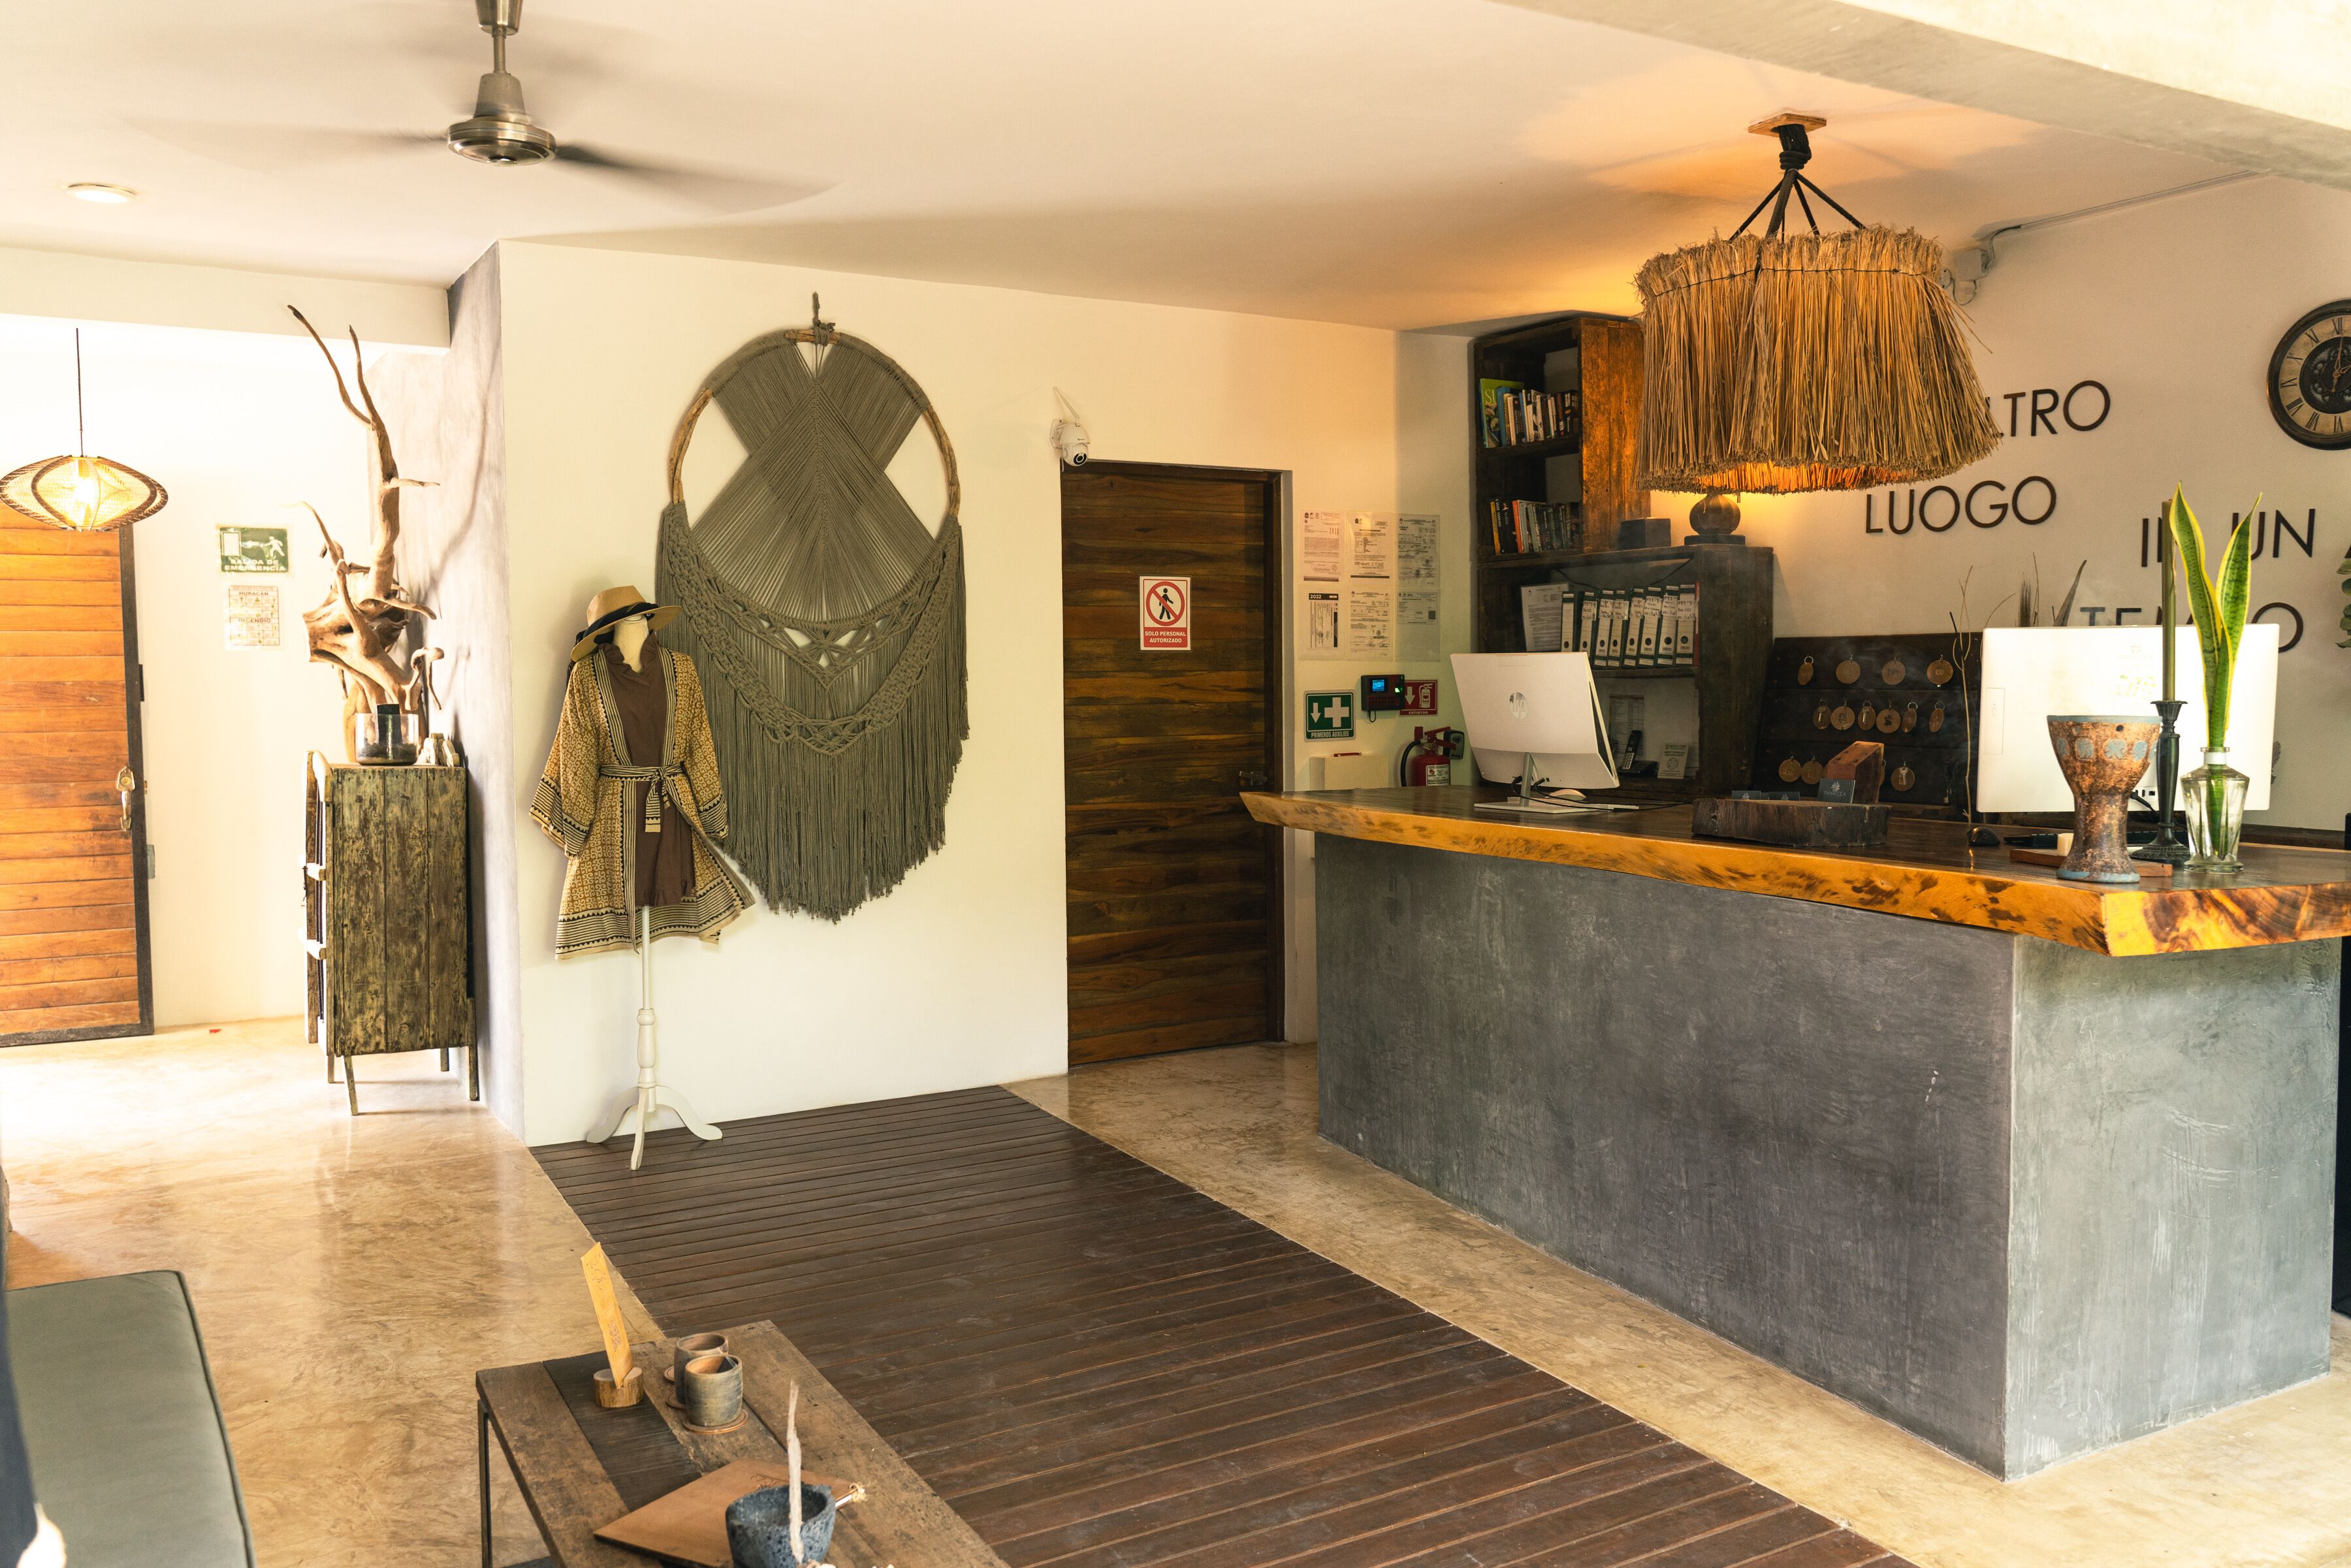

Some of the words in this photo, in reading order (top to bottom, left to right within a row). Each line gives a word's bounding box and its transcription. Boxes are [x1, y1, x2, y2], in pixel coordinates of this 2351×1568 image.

[1985, 379, 2111, 438] TRO
[1866, 475, 2056, 536] LUOGO
[2231, 508, 2316, 560] UN
